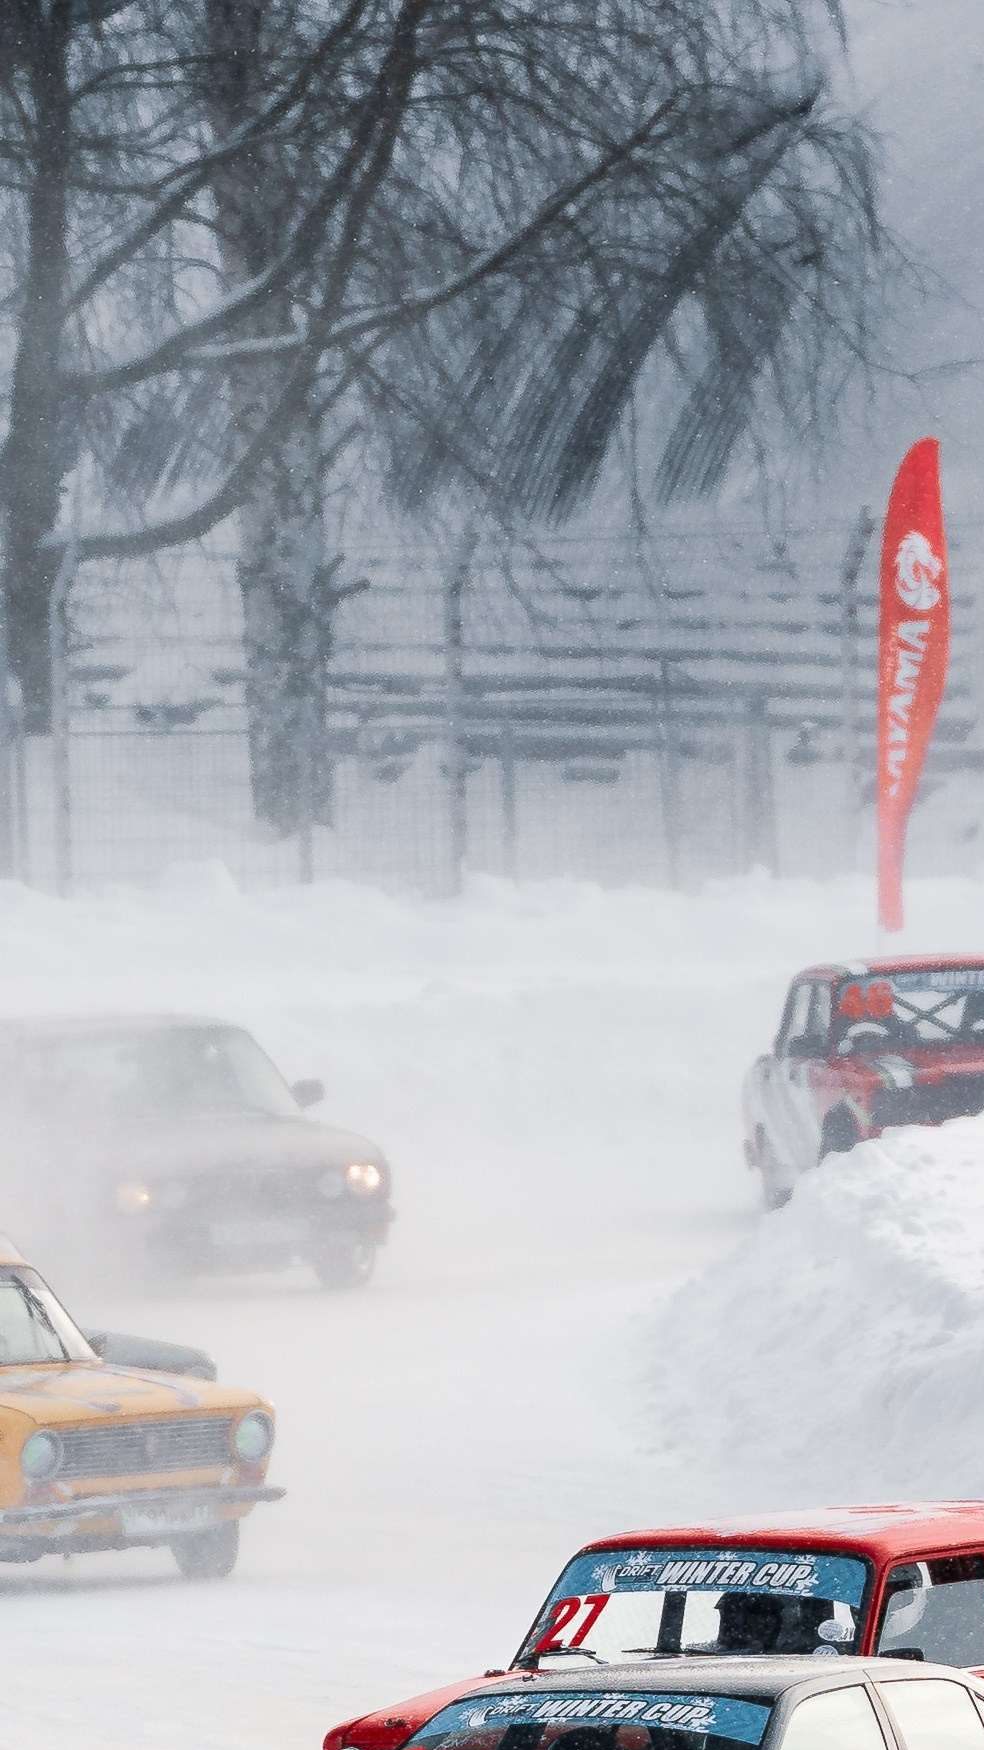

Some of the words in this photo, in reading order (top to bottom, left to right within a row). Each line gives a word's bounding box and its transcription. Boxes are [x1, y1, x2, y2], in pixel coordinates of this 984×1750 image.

[618, 1564, 664, 1577] DRIFT
[656, 1560, 757, 1586] WINTER
[752, 1563, 813, 1588] CUP
[533, 1593, 612, 1651] 27
[492, 1703, 540, 1716] DRIFT
[532, 1699, 648, 1720] WINTER
[641, 1702, 712, 1725] CUP
